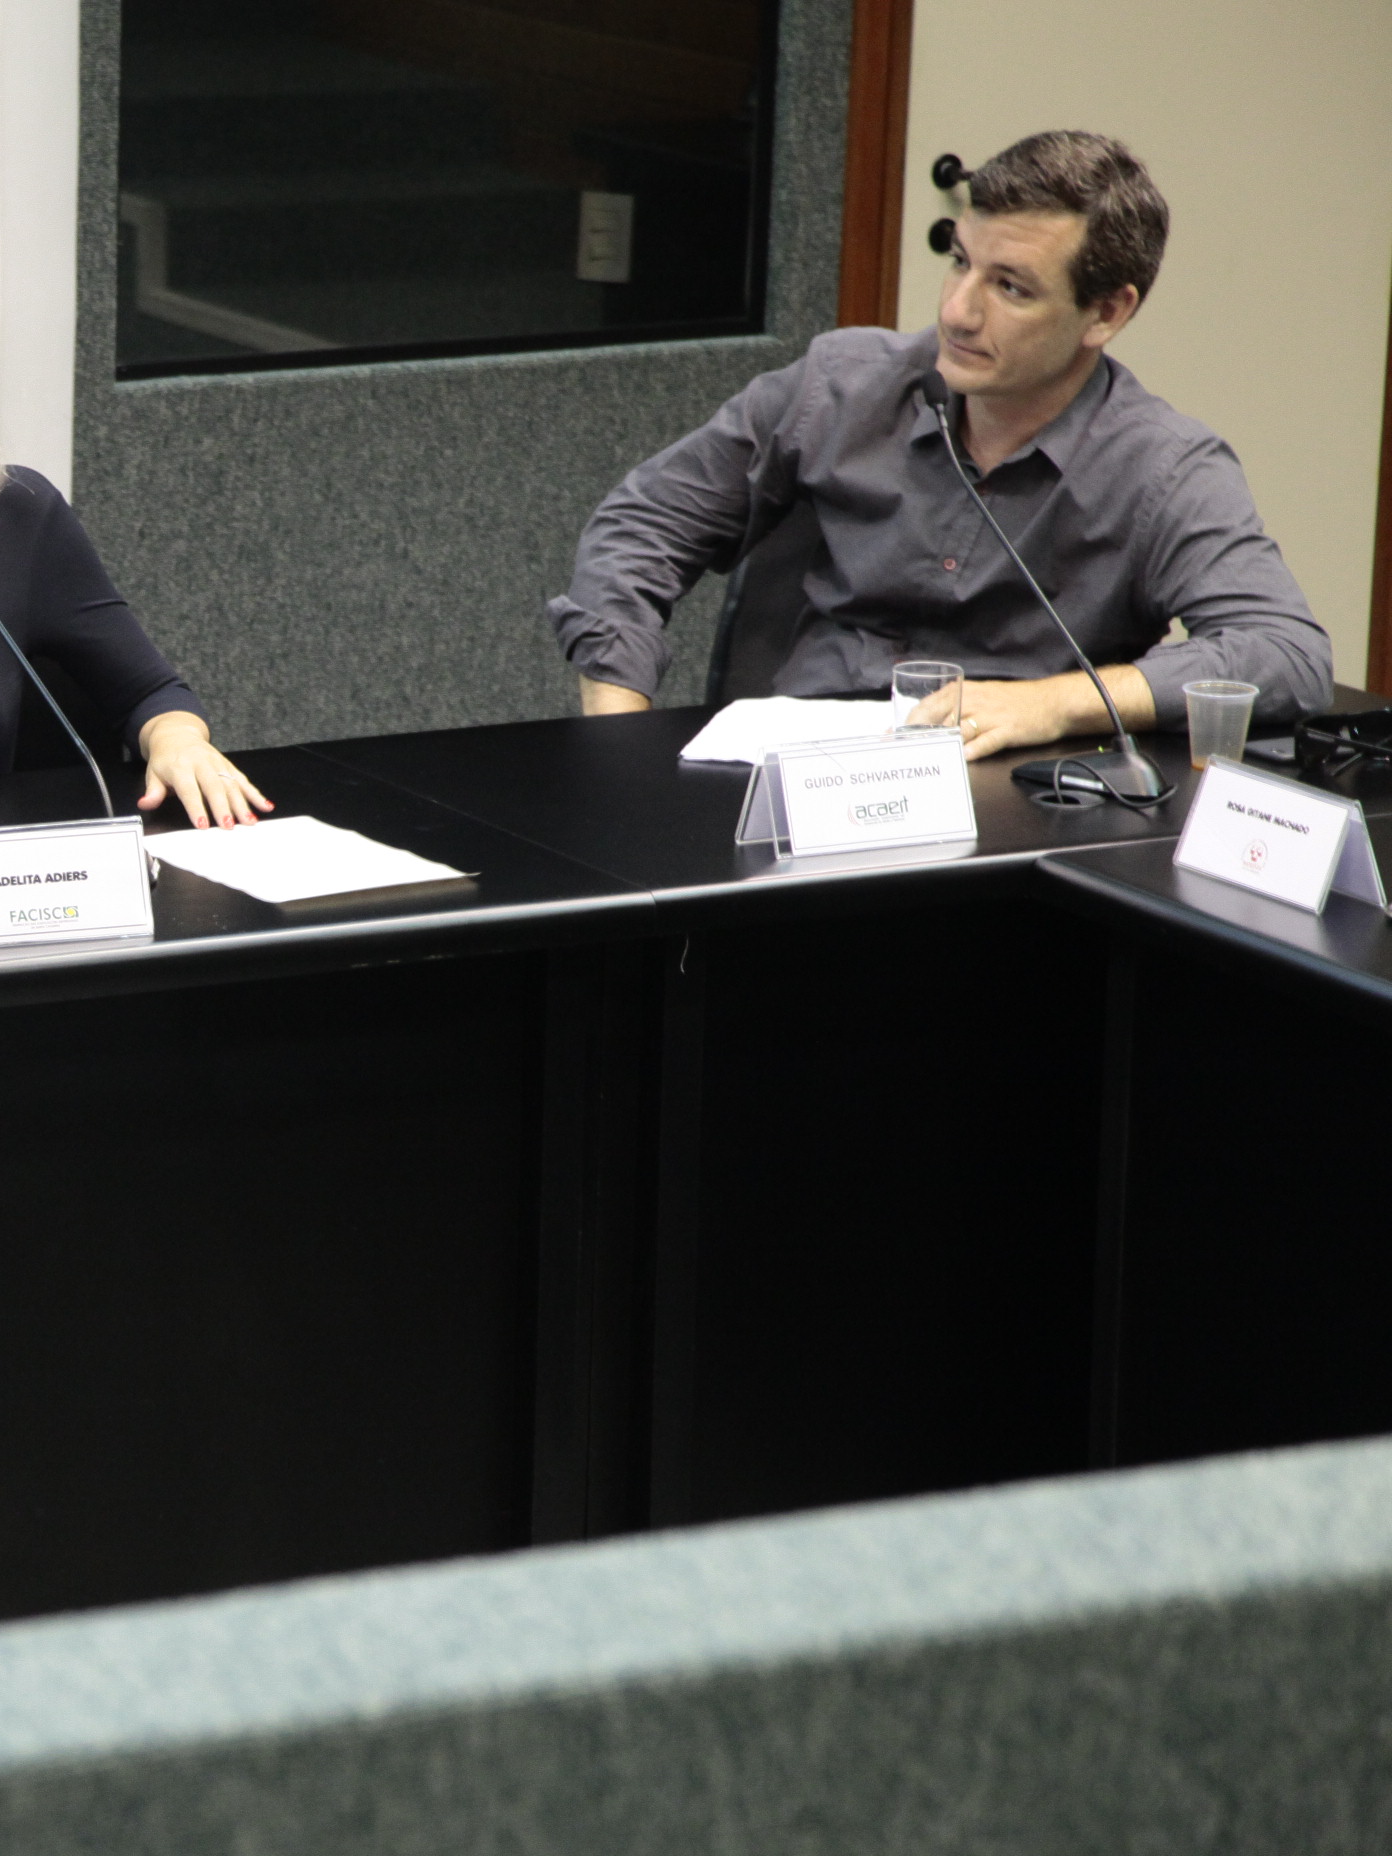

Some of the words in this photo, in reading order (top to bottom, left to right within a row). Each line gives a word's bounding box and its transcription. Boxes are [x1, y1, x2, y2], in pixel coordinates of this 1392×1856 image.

[804, 775, 844, 789] GUIDO
[850, 765, 941, 785] SCHVARTZMAN
[45, 870, 89, 883] ADIERS
